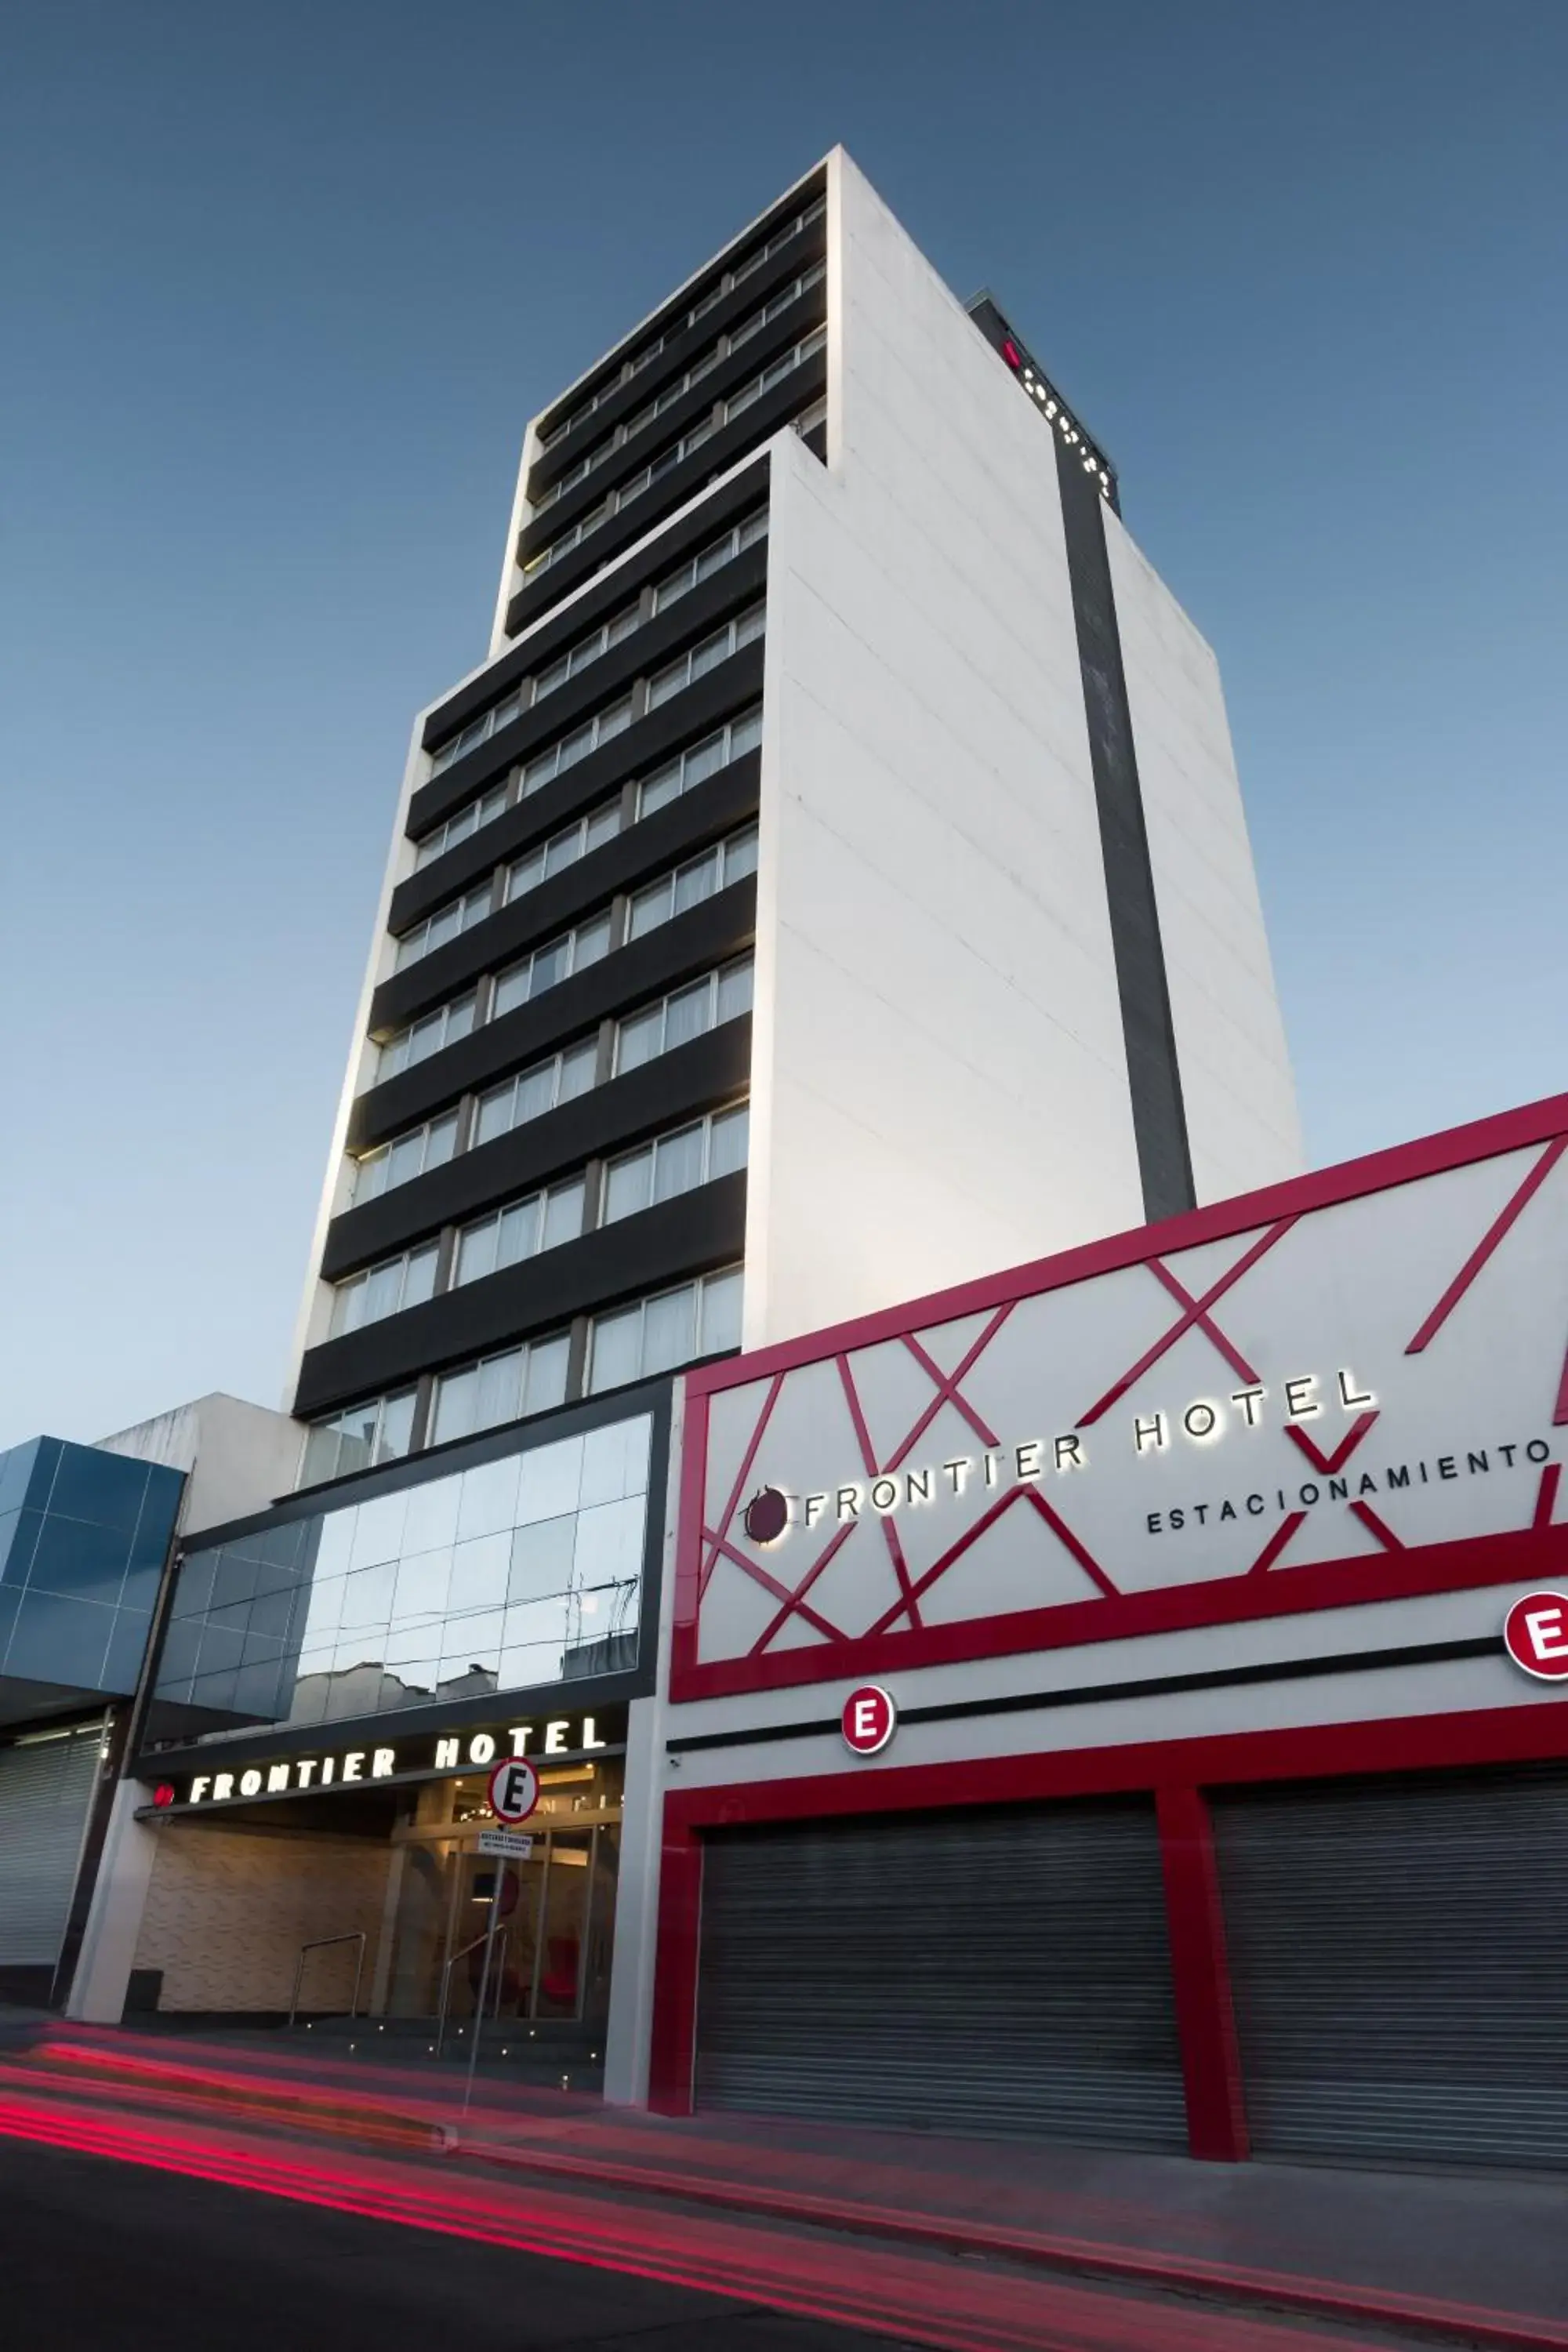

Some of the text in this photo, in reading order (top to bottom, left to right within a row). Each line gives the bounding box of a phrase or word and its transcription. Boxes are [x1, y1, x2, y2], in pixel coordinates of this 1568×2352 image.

[804, 1370, 1371, 1526] FRONTIER HOTEL
[1146, 1438, 1551, 1534] ESTACIONAMIENTO
[1524, 1608, 1568, 1660] E
[855, 1699, 877, 1738] E
[189, 1717, 607, 1804] FRONTIER HOTEL
[503, 1766, 528, 1813] E
